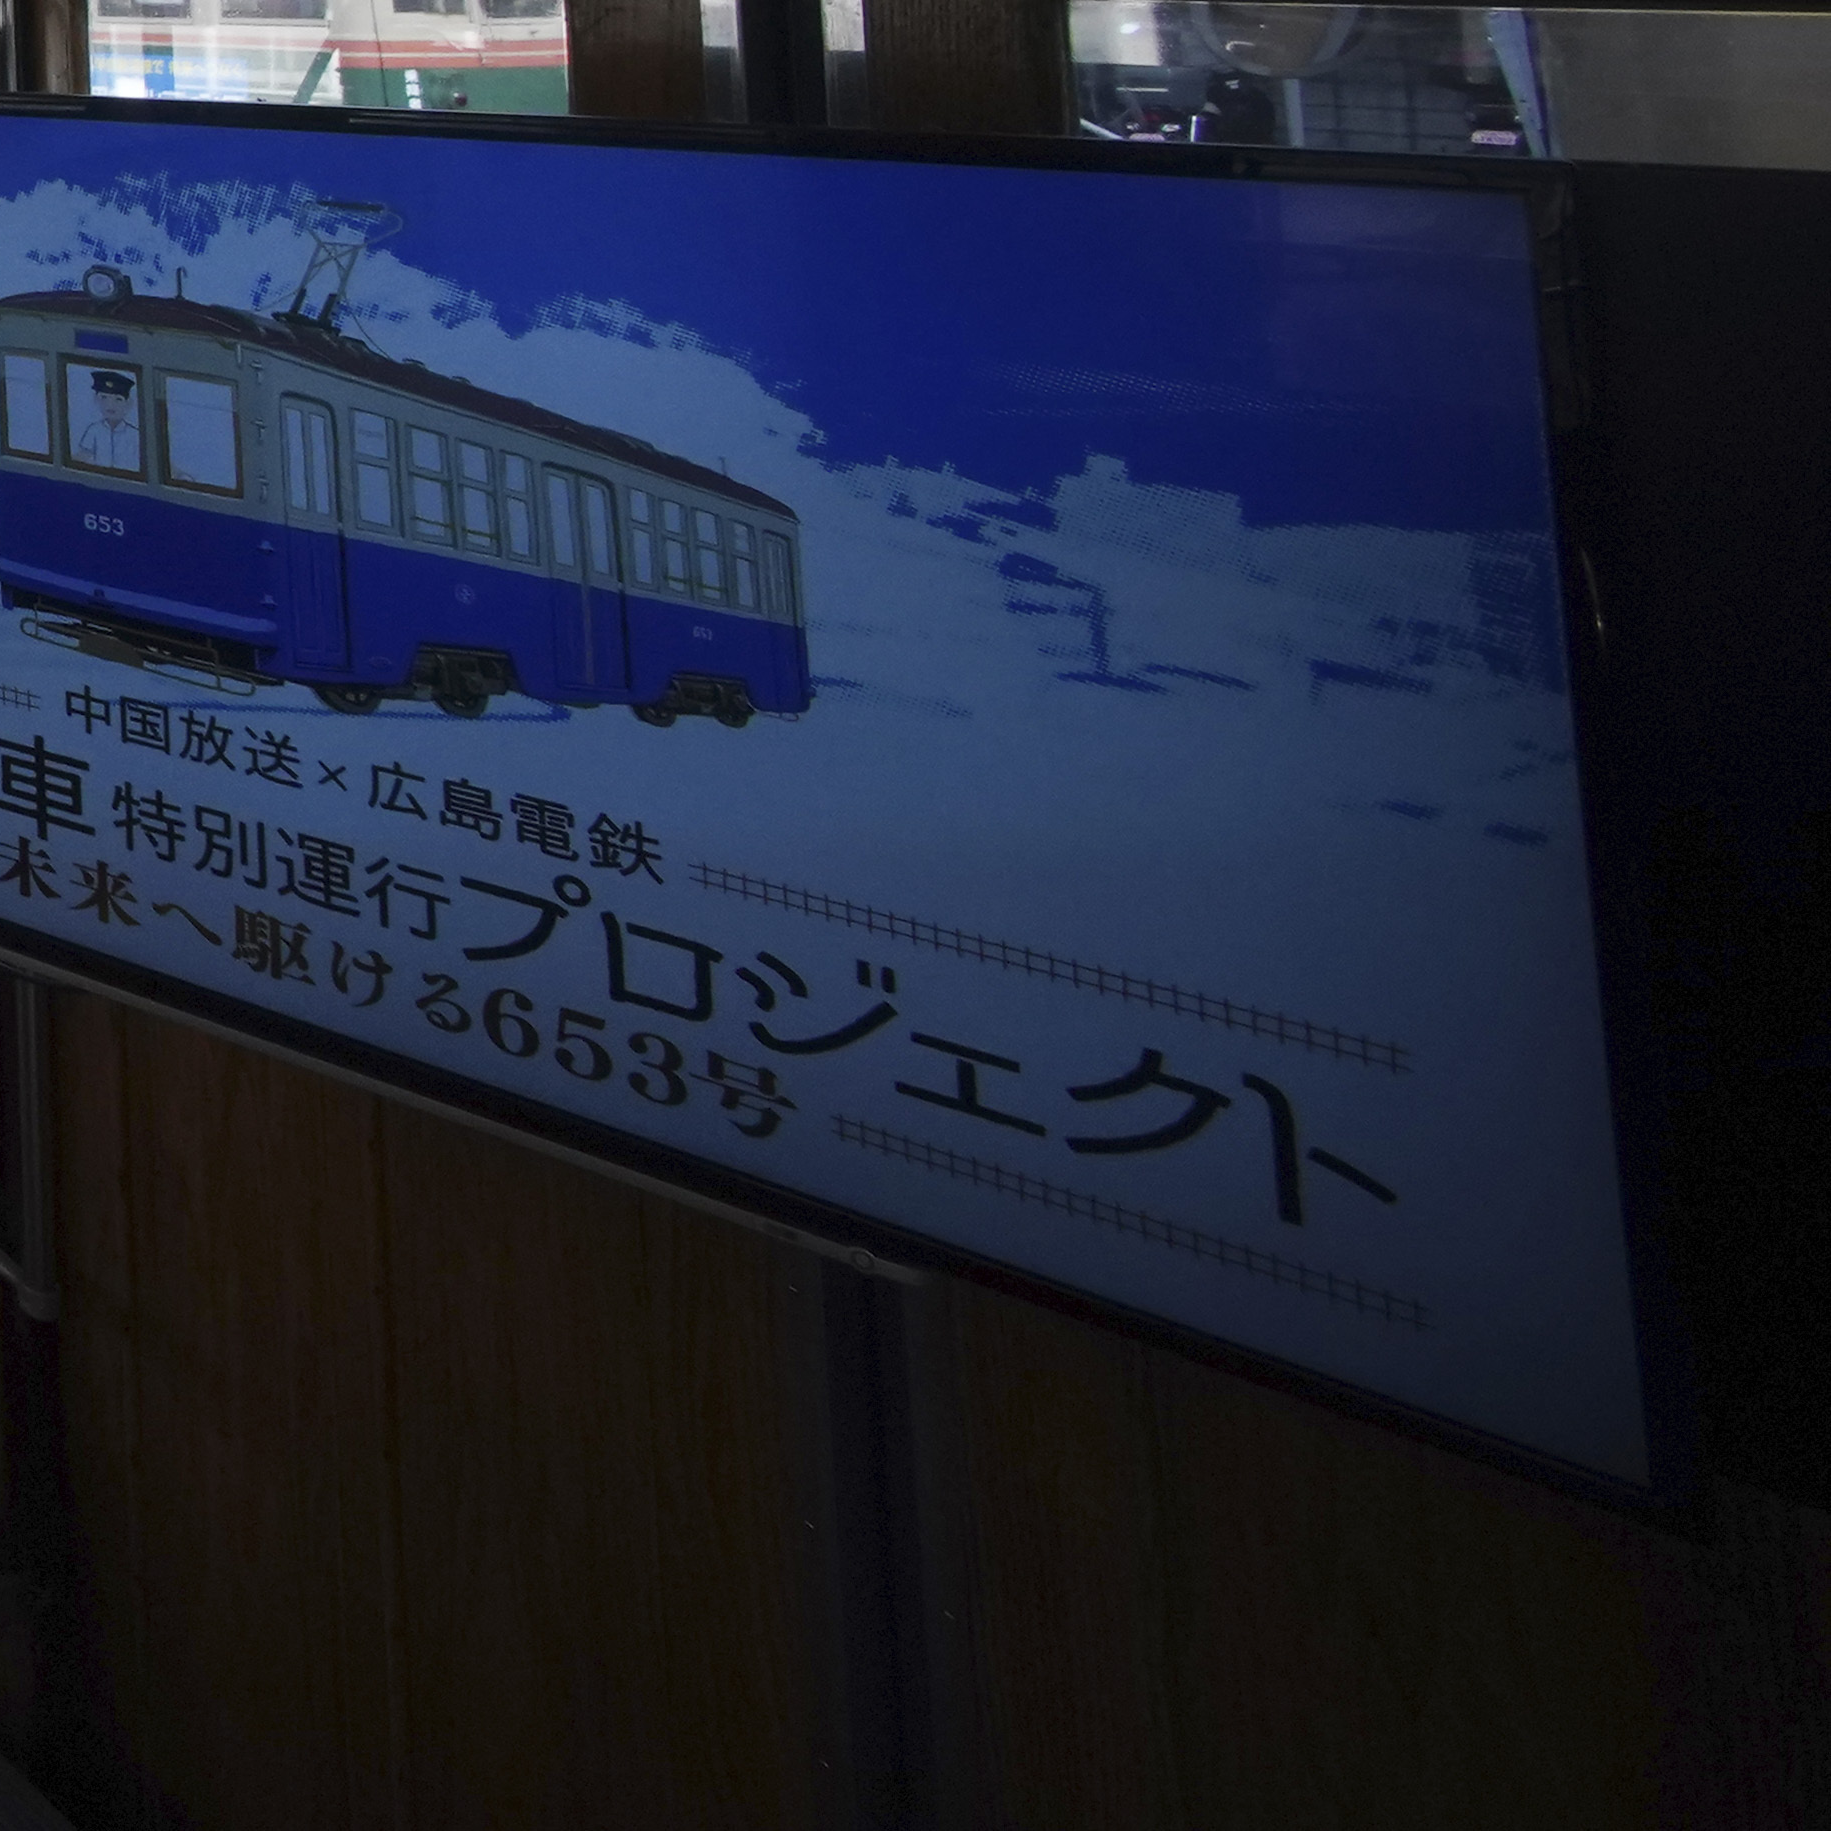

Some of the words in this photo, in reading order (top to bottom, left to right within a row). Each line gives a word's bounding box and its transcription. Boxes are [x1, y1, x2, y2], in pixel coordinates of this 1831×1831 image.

[84, 512, 125, 537] 653
[63, 685, 666, 886] 中国放送×広島電鉄
